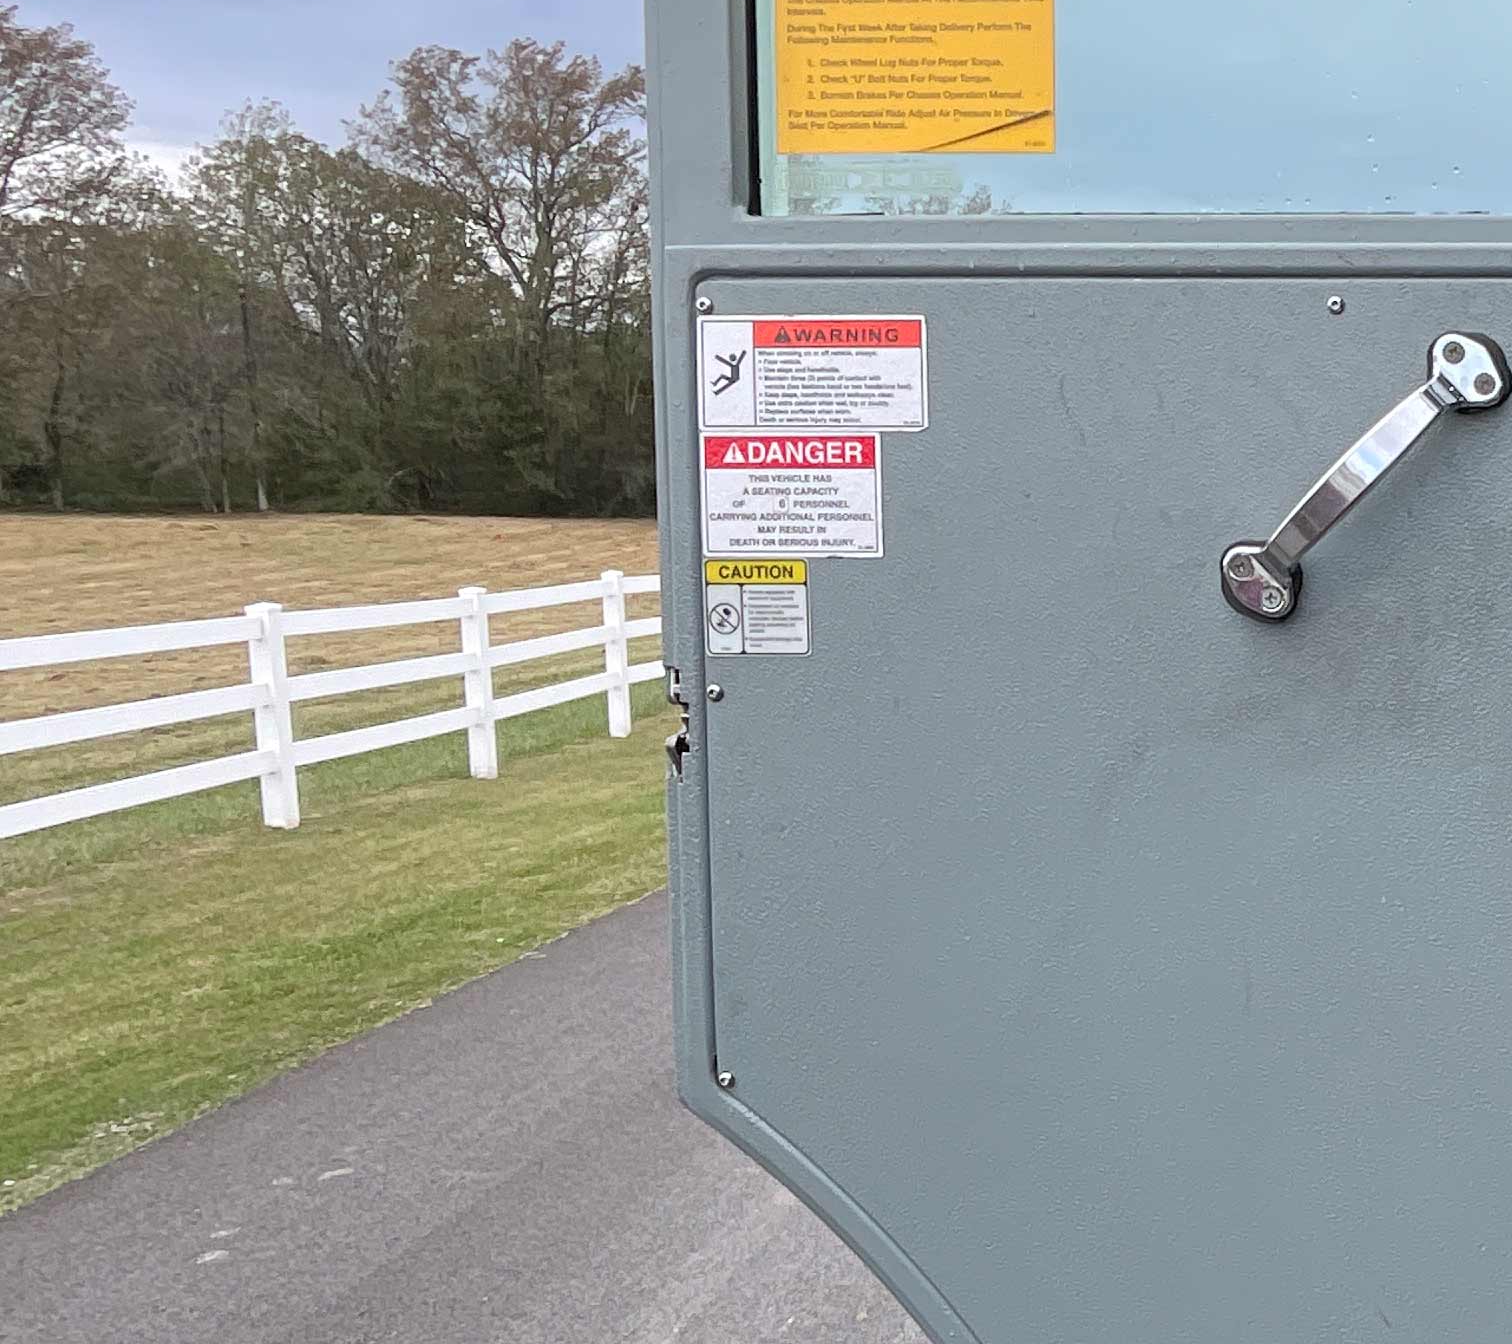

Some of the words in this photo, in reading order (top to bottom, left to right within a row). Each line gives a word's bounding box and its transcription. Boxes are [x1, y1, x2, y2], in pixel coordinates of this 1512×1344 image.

[793, 328, 899, 343] WARNING
[748, 442, 864, 464] DANGER
[749, 474, 770, 482] THIS
[772, 474, 810, 482] VEHICLE
[813, 474, 832, 482] HAS
[742, 488, 750, 496] A
[752, 488, 791, 496] SEATING
[793, 488, 839, 496] CAPACITY
[732, 500, 746, 508] OF
[793, 500, 850, 508] PERSONNEL
[710, 514, 757, 522] CARRYING
[759, 514, 815, 522] ADDITIONAL
[818, 514, 874, 522] PERSONNEL
[758, 526, 777, 534] MAY
[779, 526, 814, 534] RESULT
[816, 526, 826, 534] IN
[729, 538, 760, 546] DEATH
[762, 538, 776, 546] OR
[778, 538, 819, 546] SERIOUS
[718, 565, 794, 579] CAUTION
